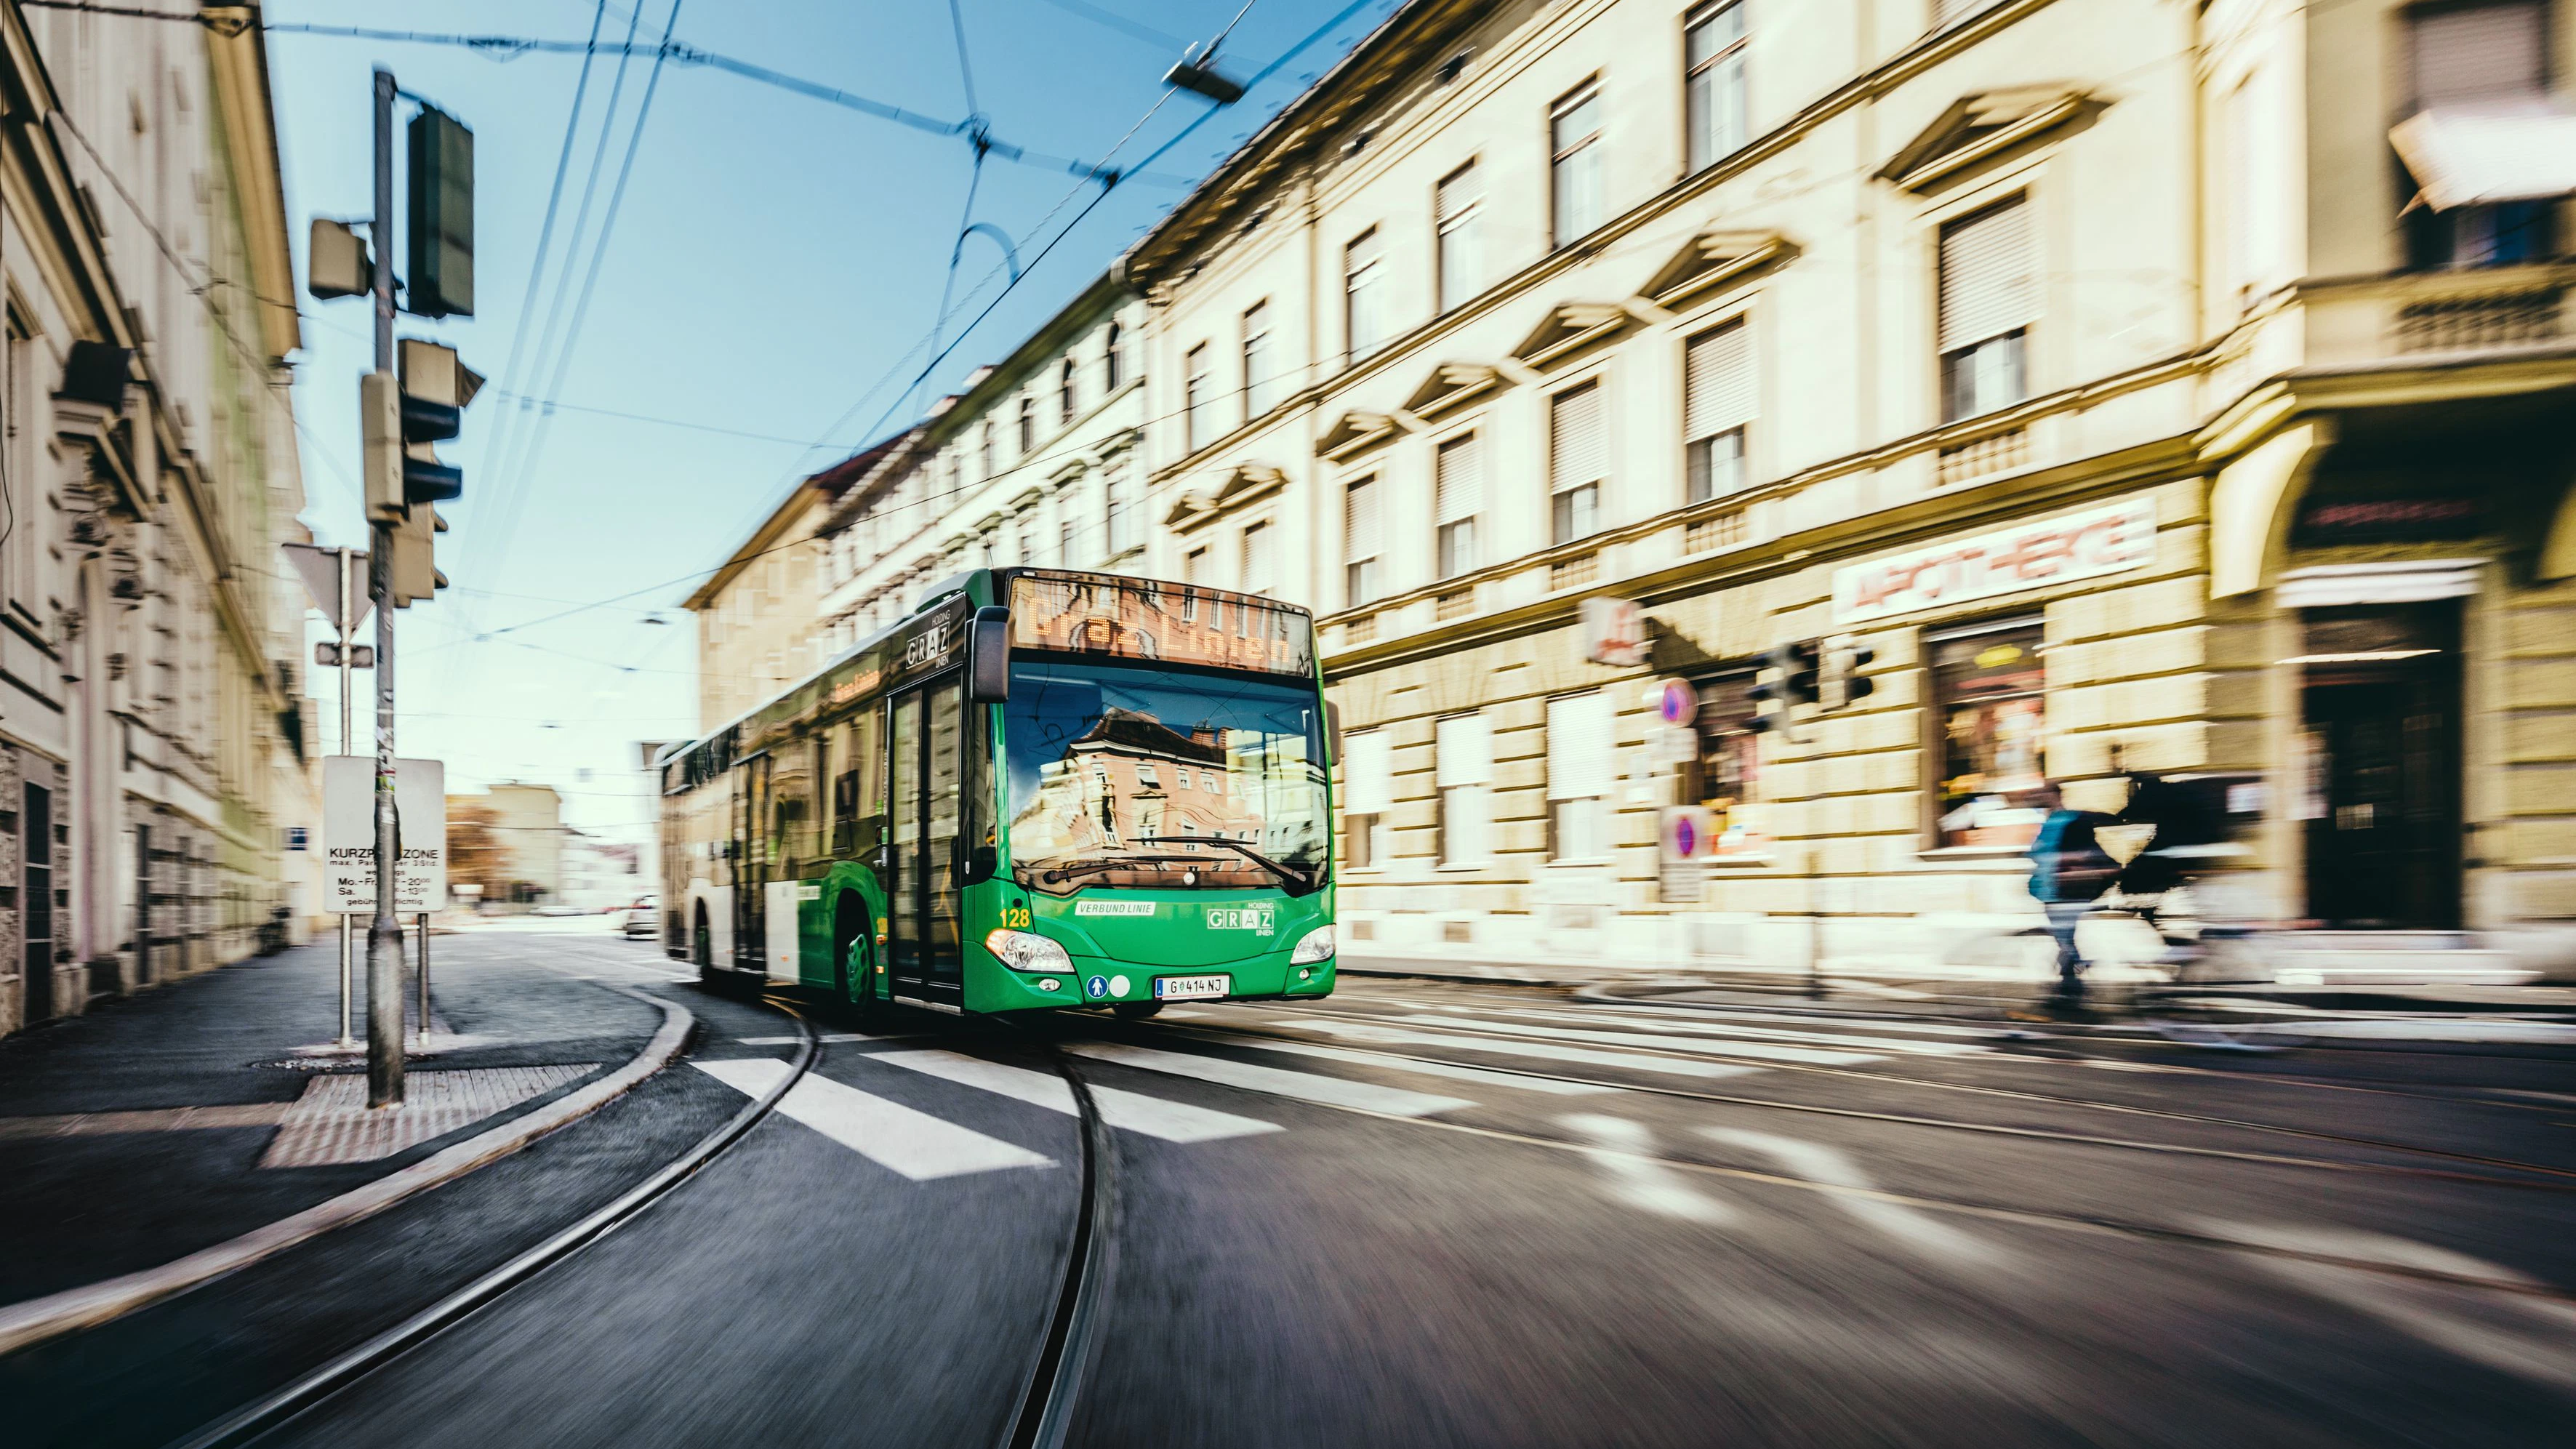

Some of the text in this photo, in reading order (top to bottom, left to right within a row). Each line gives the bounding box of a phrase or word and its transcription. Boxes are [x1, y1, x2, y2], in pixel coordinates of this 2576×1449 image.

[931, 609, 950, 626] HOLDING
[1029, 598, 1290, 662] Graz Linien
[907, 626, 948, 665] GRAZ
[1080, 904, 1152, 913] VERBUND LINIE
[1000, 908, 1030, 928] 128
[1209, 911, 1271, 927] GRAZ
[1171, 981, 1177, 993] G
